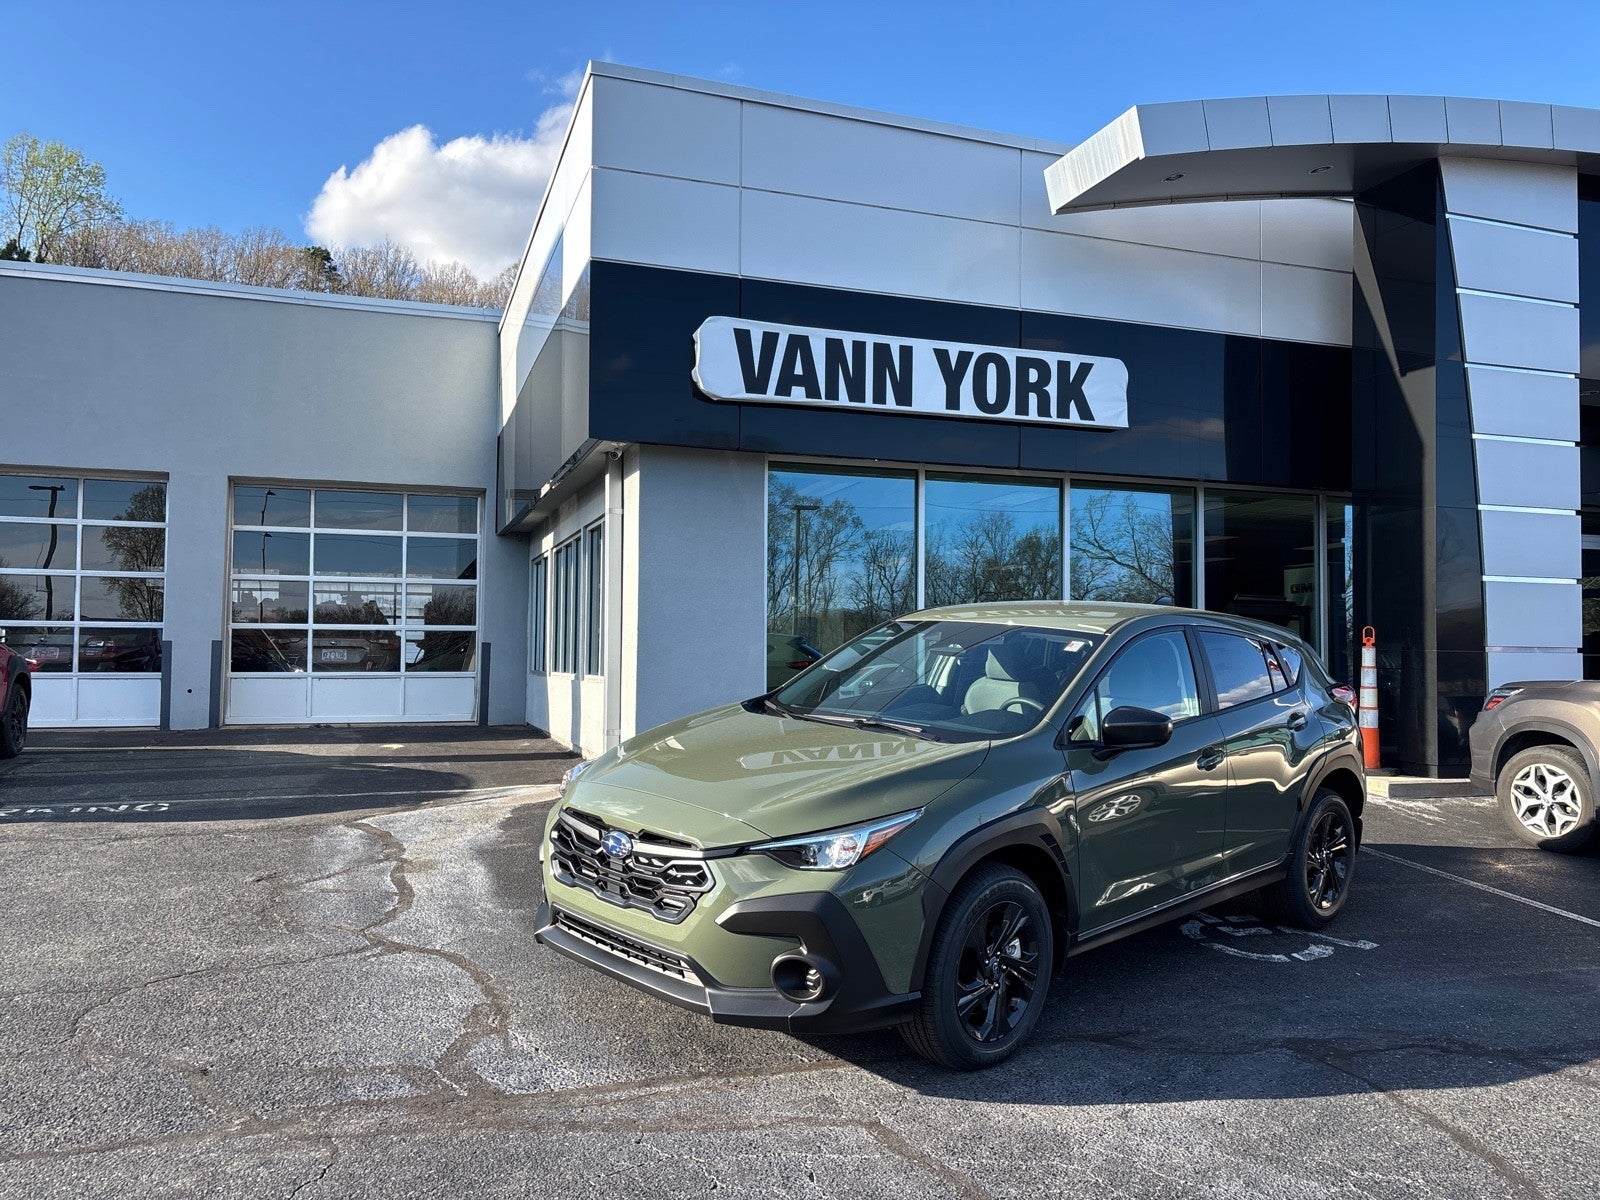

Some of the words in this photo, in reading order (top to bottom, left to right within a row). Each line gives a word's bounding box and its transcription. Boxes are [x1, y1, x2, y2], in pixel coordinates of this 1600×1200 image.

[733, 328, 913, 407] VANN
[933, 348, 1095, 421] YORK
[1290, 582, 1315, 594] GM
